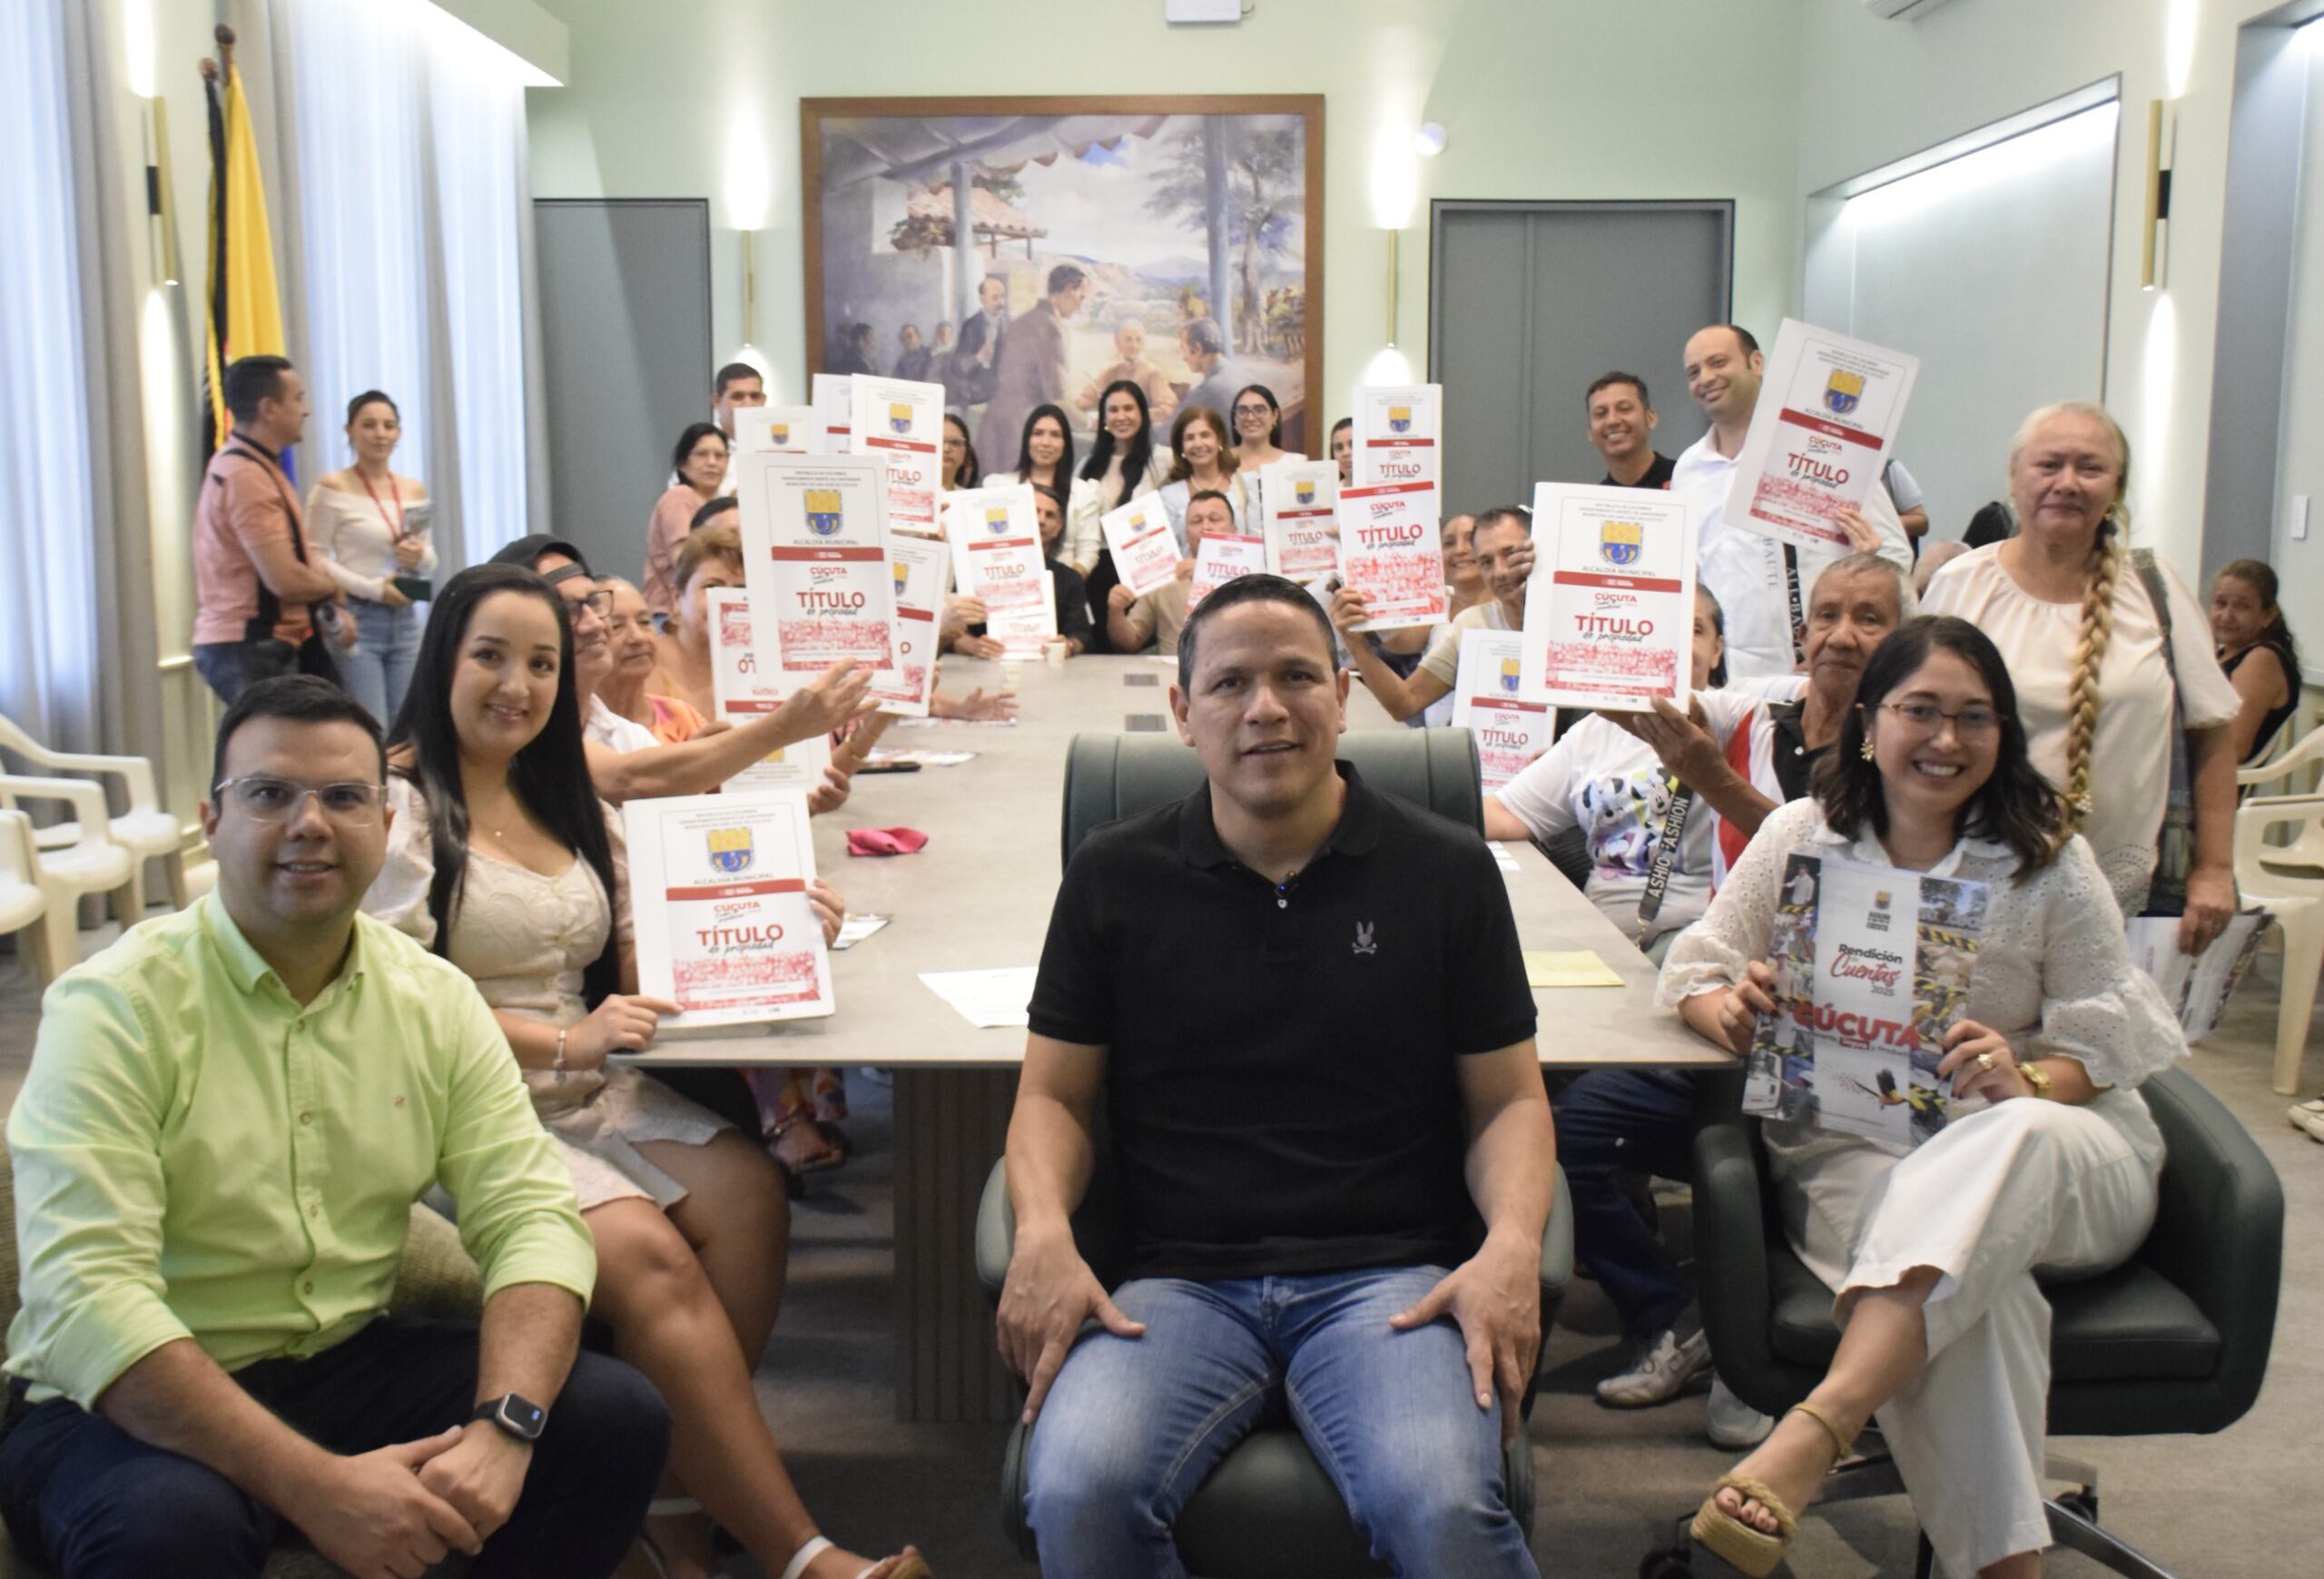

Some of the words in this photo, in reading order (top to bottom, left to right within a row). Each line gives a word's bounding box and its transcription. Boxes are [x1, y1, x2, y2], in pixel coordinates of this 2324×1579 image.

[1379, 461, 1422, 474] TÍTULO
[1787, 452, 1849, 485] TÍTULO
[1357, 524, 1423, 544] TÍTULO
[796, 587, 865, 608] TÍTULO
[1574, 612, 1654, 637] TÍTULO
[1482, 726, 1529, 745] TÍTULO
[1660, 796, 1689, 851] ASHION
[696, 923, 784, 947] TÍTULO
[1838, 943, 1904, 964] Rendición
[1830, 952, 1902, 987] Cuentas
[1871, 984, 1896, 997] 2025
[1792, 1001, 1920, 1051] CÚCUTA
